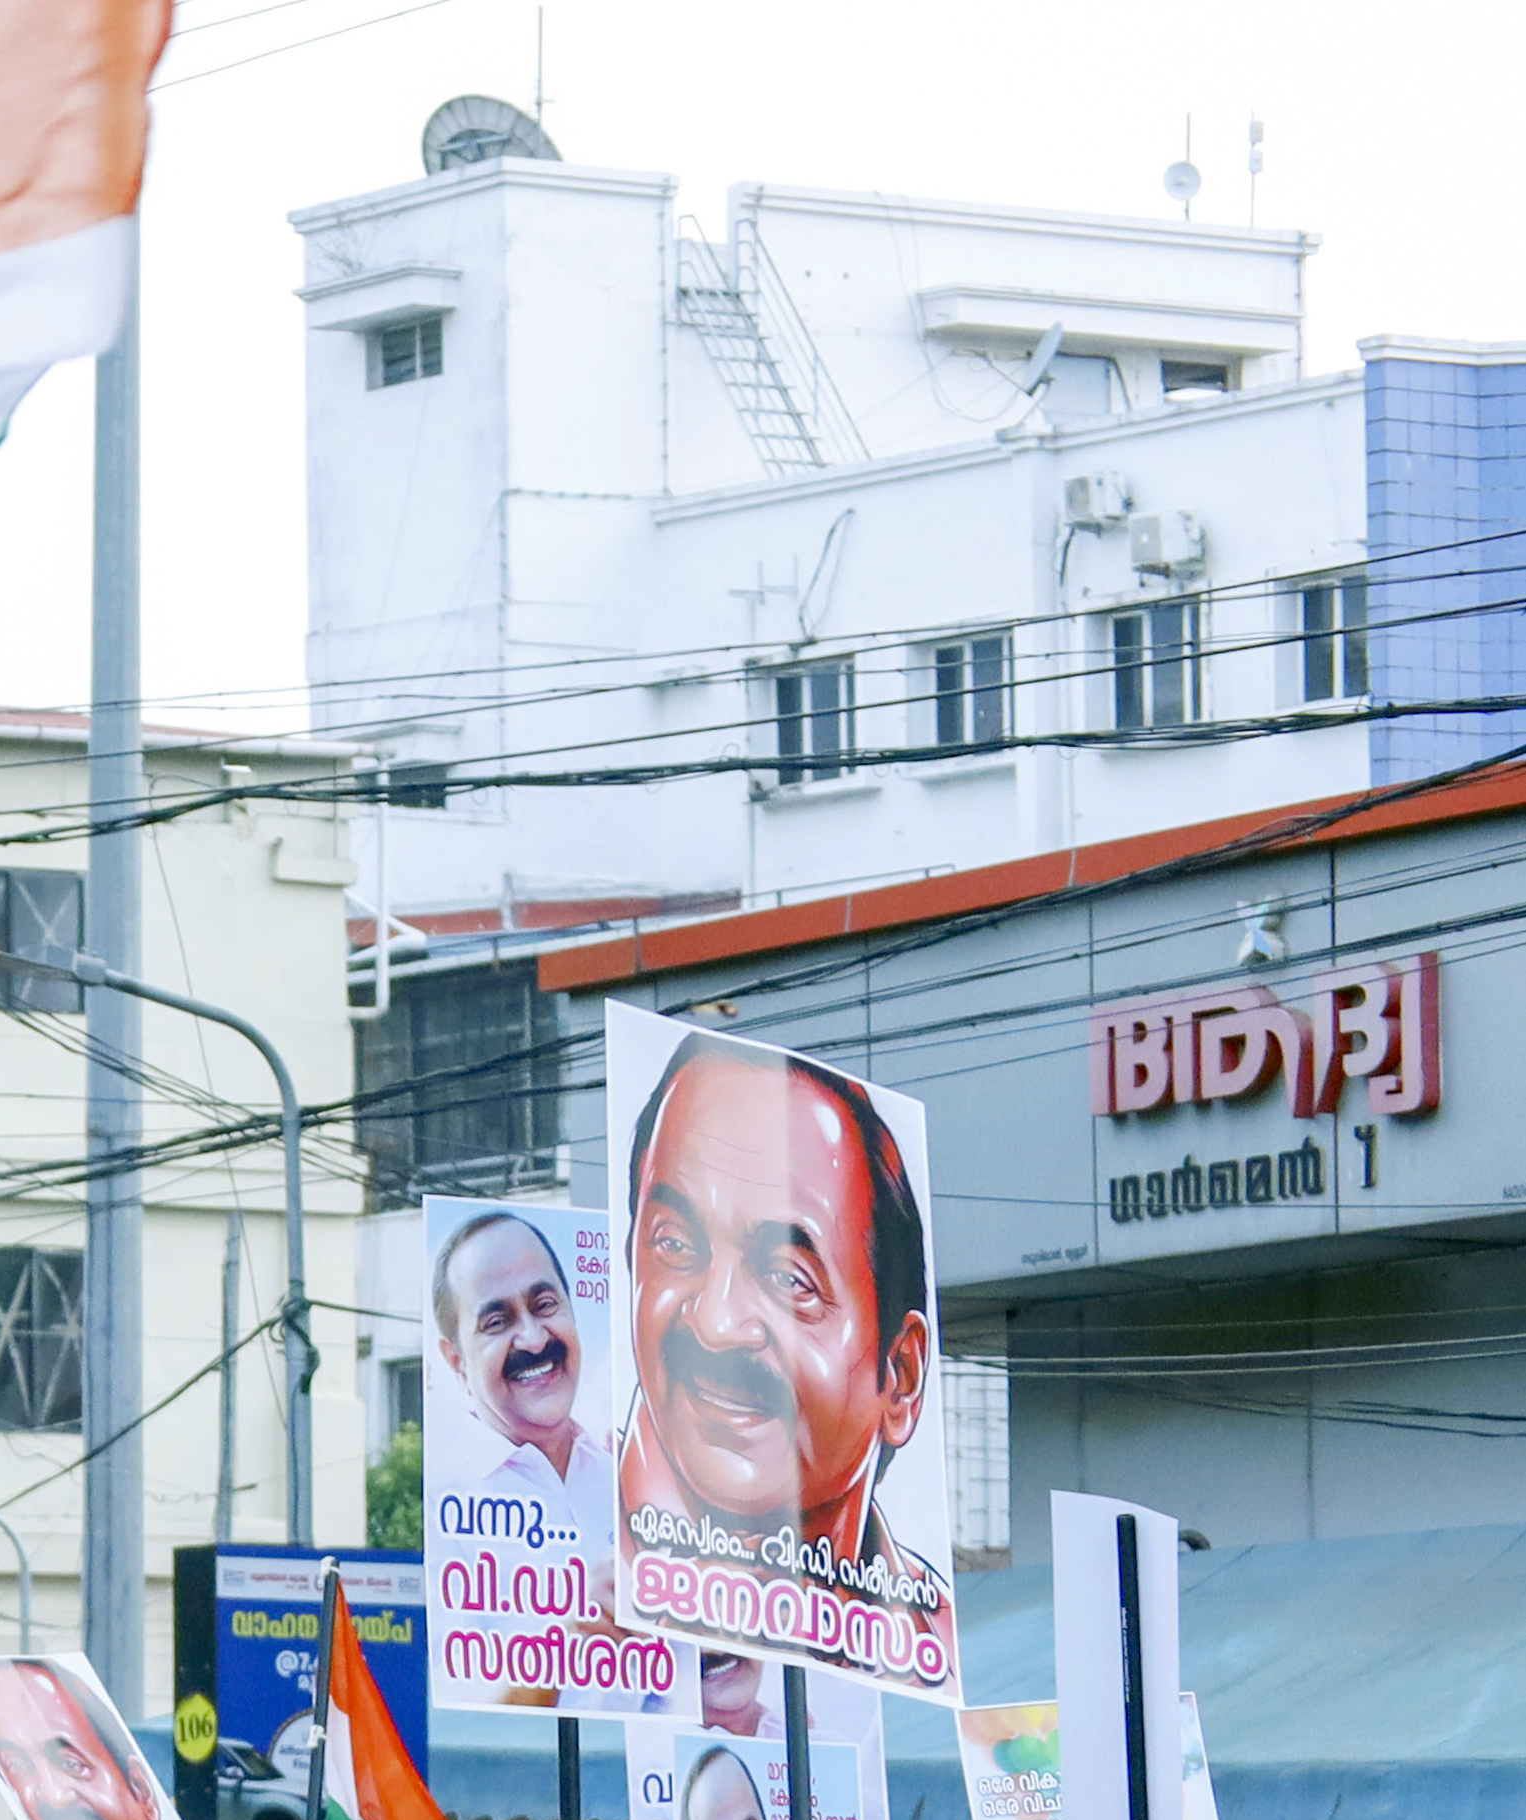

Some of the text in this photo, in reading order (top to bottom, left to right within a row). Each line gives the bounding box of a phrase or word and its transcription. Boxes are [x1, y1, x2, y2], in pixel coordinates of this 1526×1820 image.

[441, 1495, 577, 1549] വന്നു...
[442, 1553, 600, 1618] വി.ഡി.
[635, 1556, 947, 1677] ജനവാസം
[445, 1626, 674, 1694] സതീശൻ
[179, 1714, 214, 1742] 106
